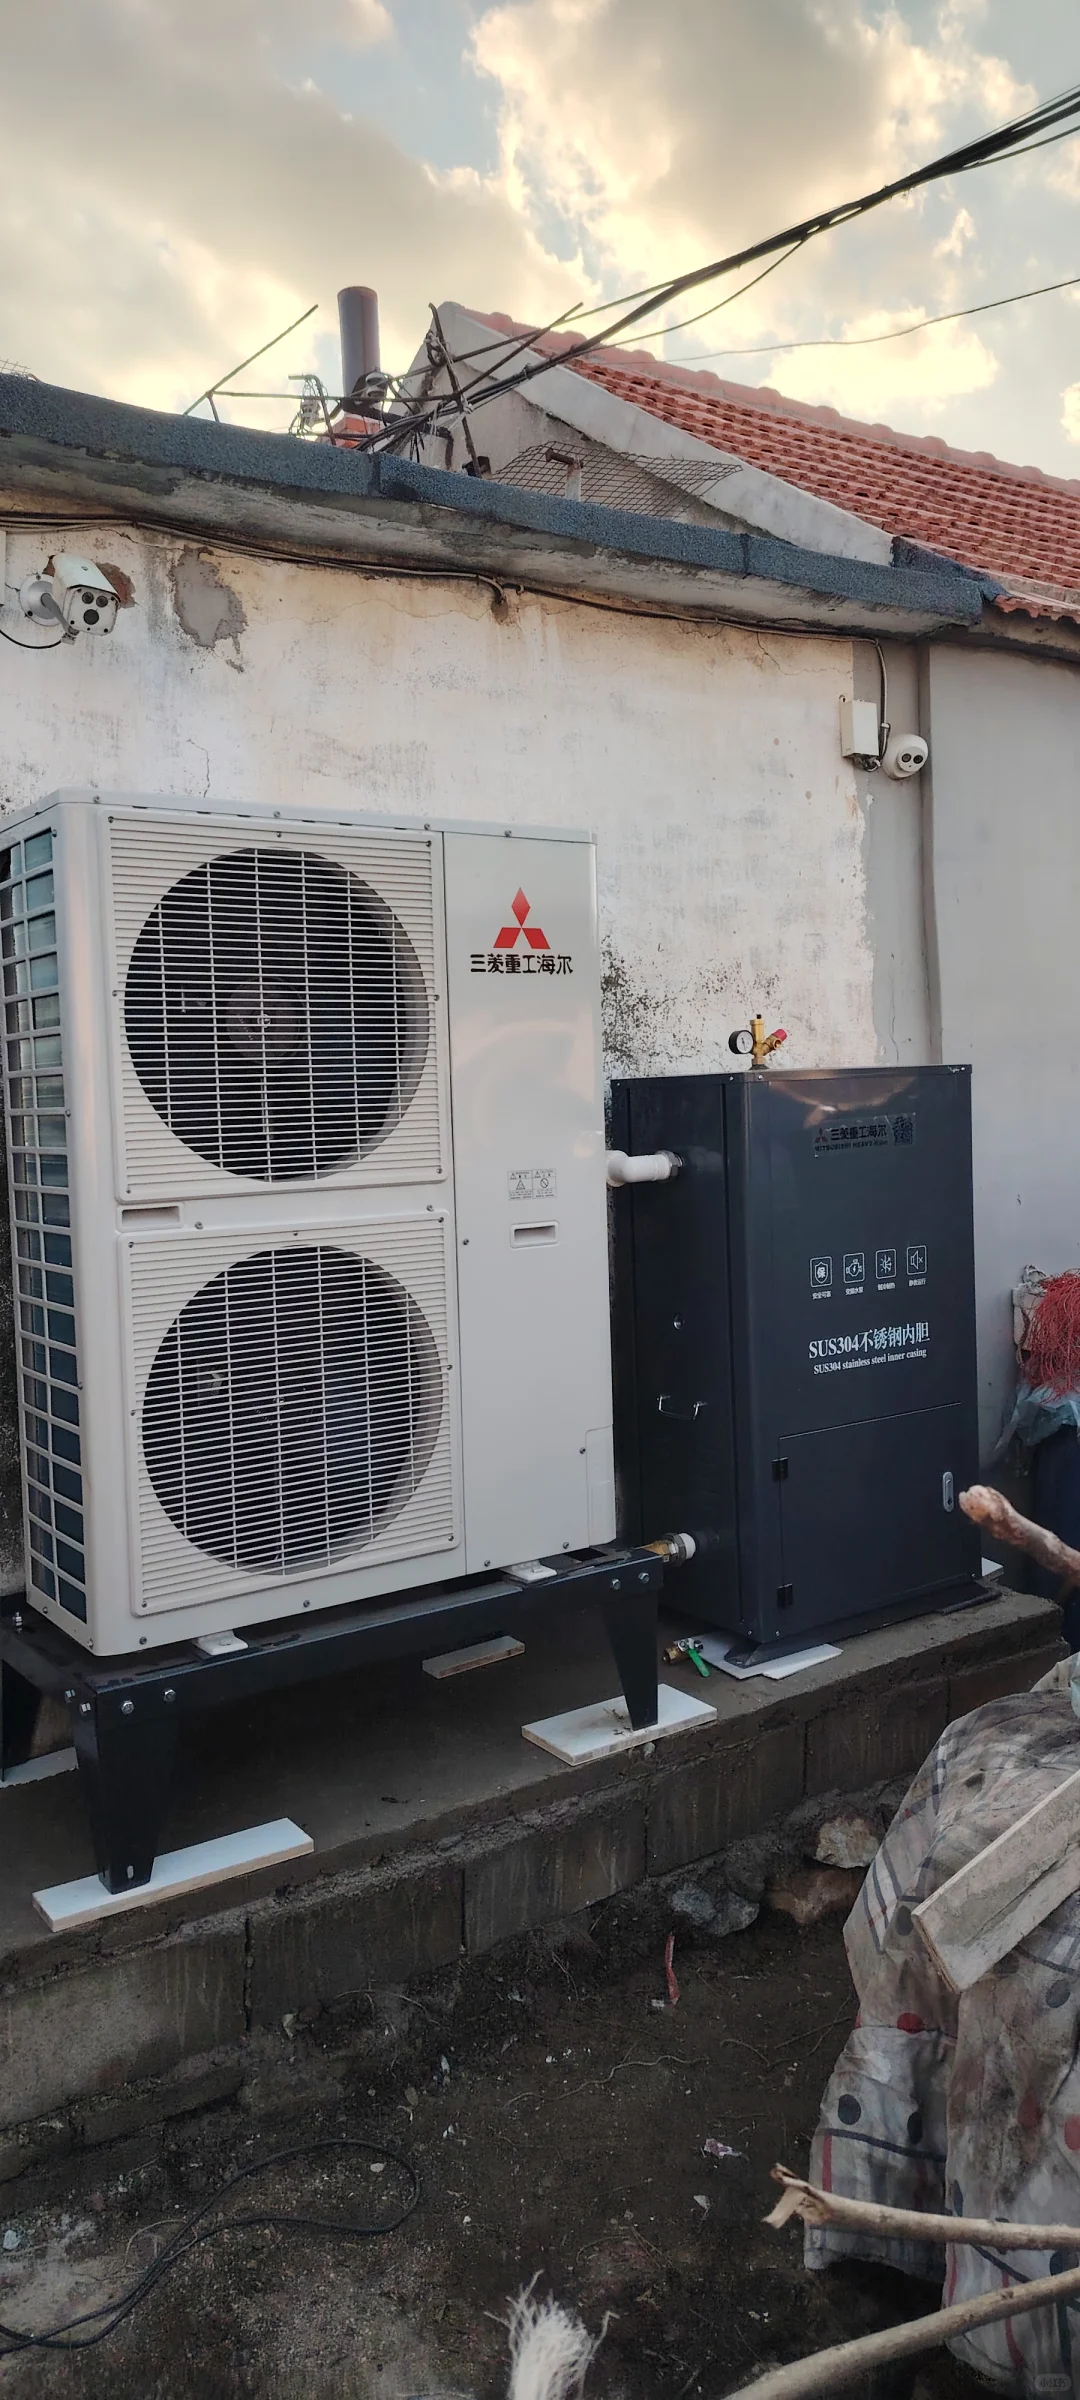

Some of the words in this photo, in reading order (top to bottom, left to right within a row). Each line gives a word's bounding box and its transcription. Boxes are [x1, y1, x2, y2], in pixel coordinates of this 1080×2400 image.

[470, 953, 574, 975] 三菱重工海尔
[831, 1124, 887, 1140] 三菱重工海尔
[852, 1141, 873, 1149] HEAVY
[809, 1322, 930, 1358] SUS304不锈钢内胆
[813, 1361, 841, 1375] SUS304
[842, 1357, 870, 1370] stainless
[871, 1353, 887, 1365] steel
[887, 1351, 905, 1362] inner
[906, 1347, 927, 1360] casing
